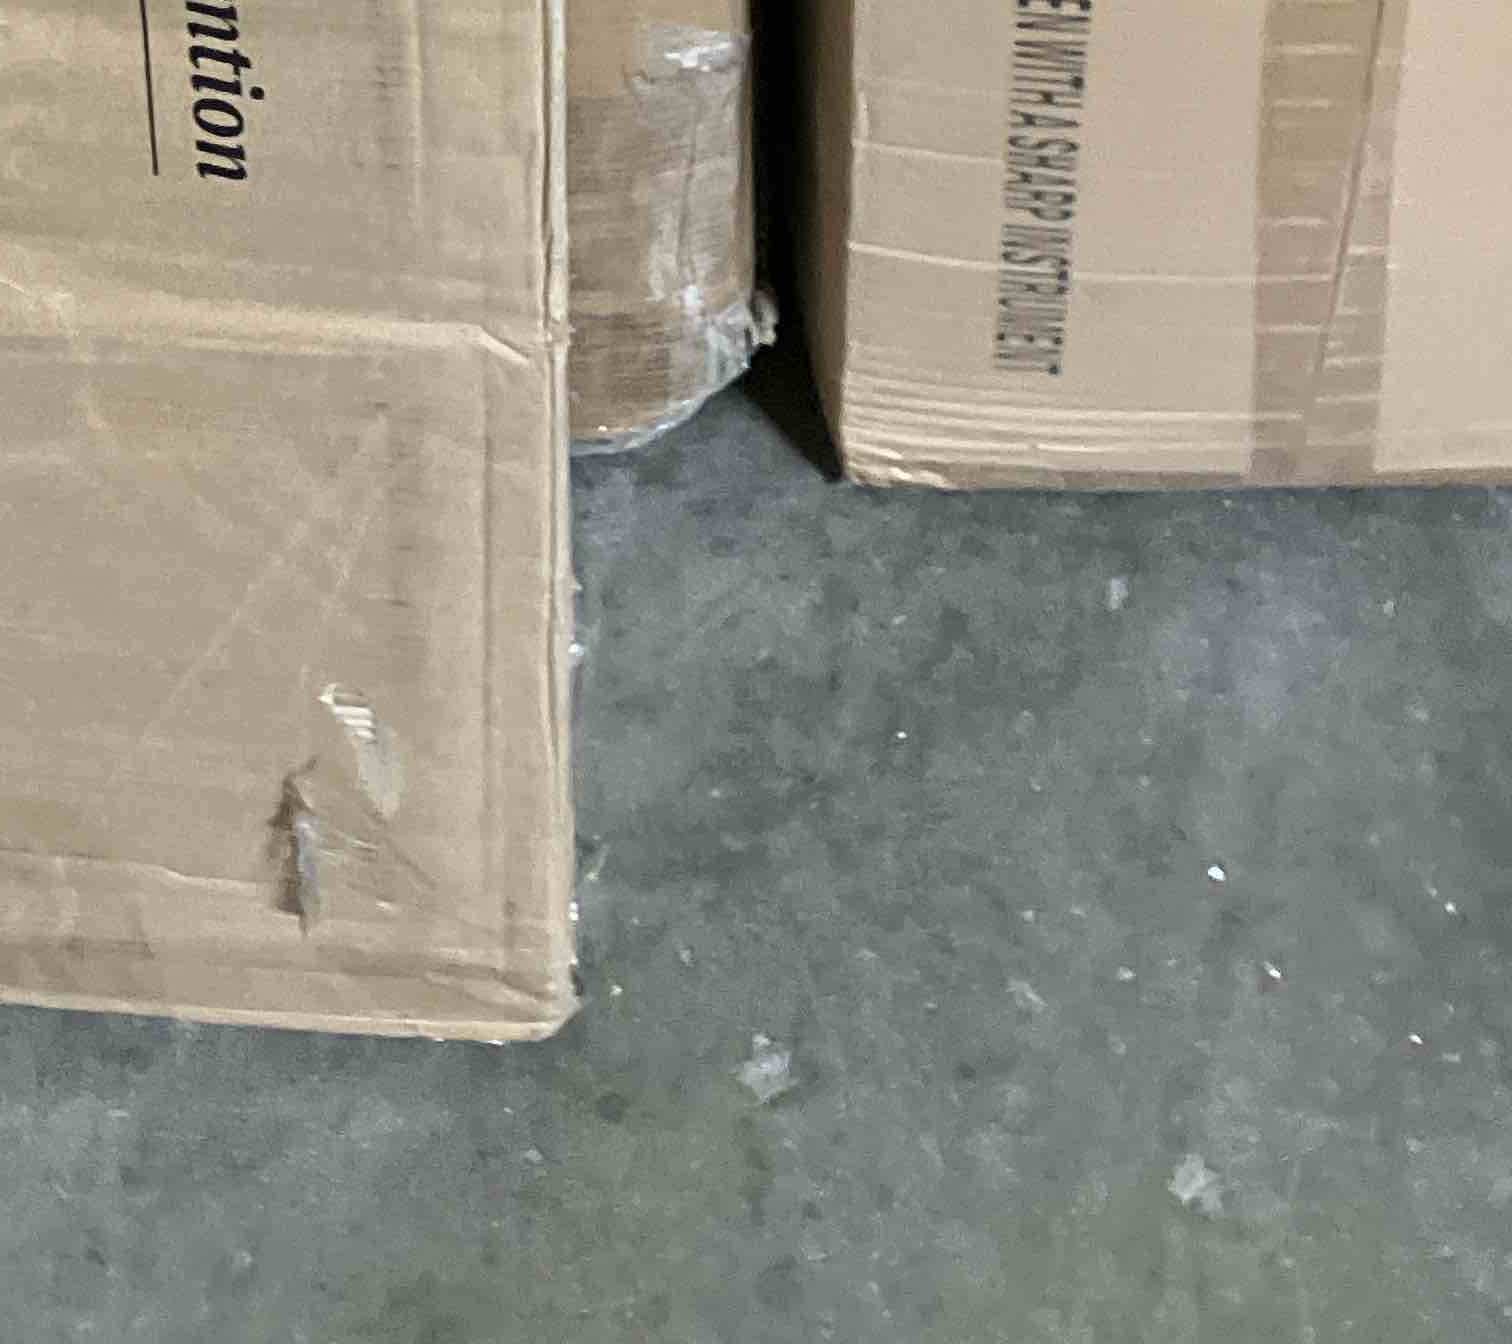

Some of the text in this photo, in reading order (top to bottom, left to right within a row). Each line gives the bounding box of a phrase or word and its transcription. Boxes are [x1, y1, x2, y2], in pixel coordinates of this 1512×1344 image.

[1007, 40, 1088, 109] WITH
[1007, 109, 1084, 129] A
[1002, 134, 1080, 222] SHARP
[992, 223, 1072, 376] INSTRUMENT
